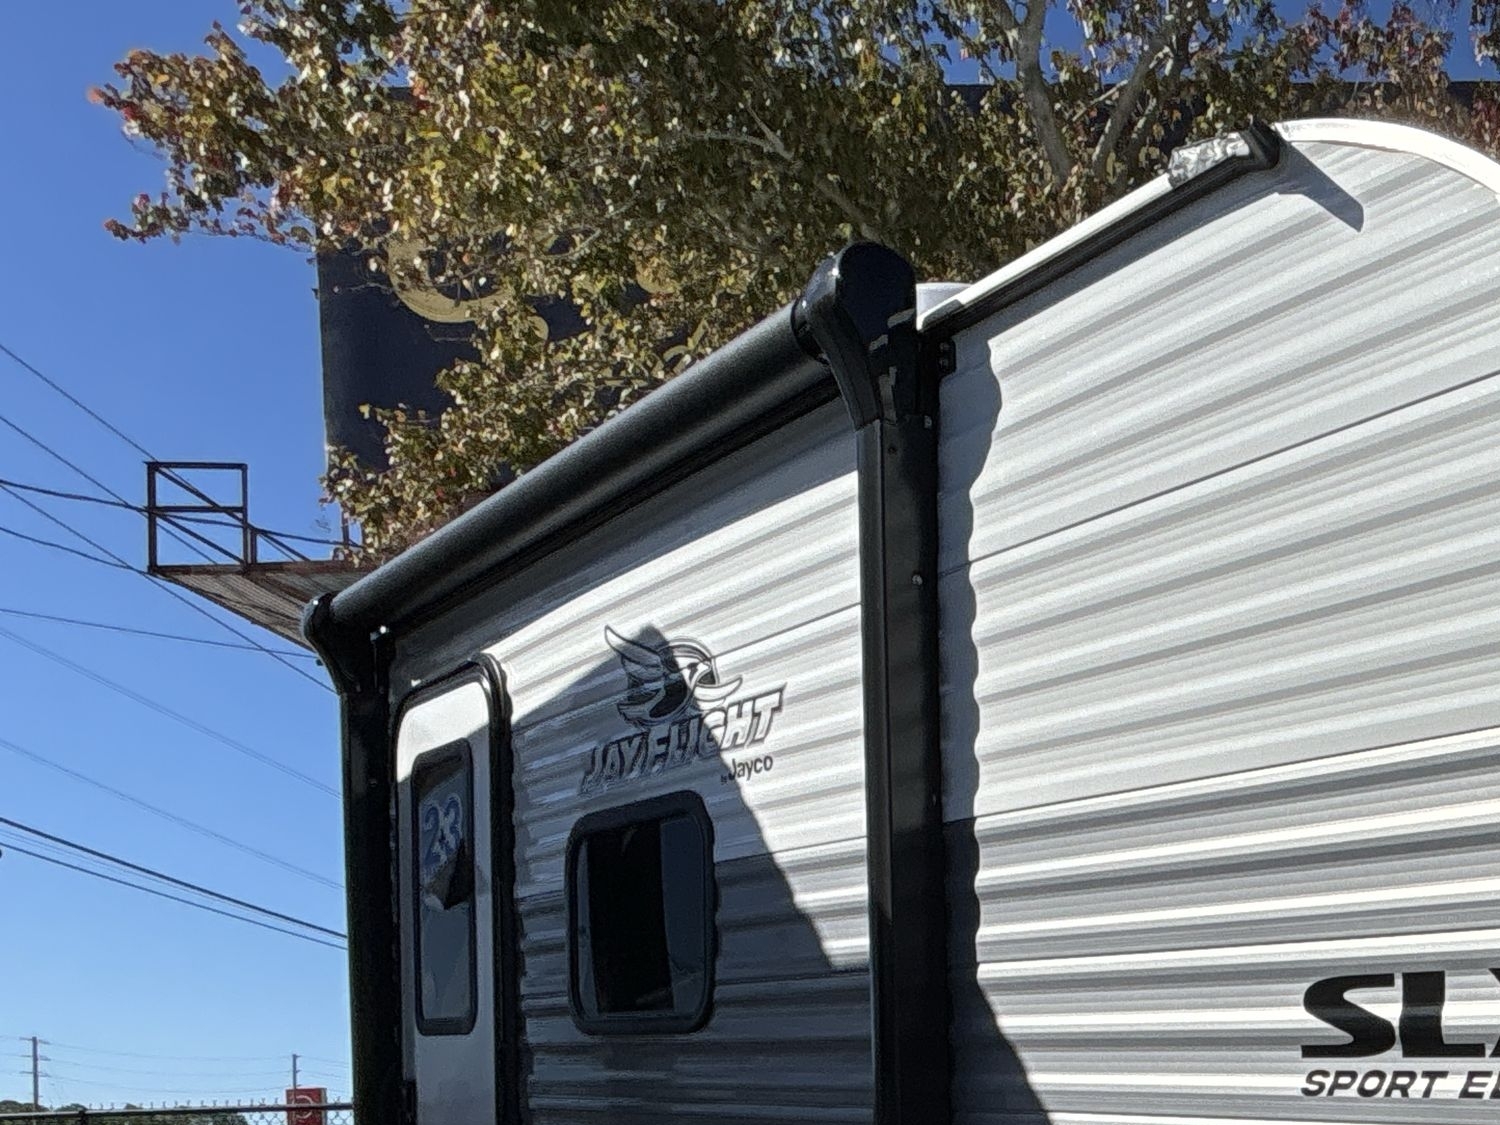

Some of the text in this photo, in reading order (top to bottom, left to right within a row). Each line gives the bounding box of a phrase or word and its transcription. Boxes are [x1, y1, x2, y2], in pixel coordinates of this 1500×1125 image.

[580, 687, 785, 793] JAY FLIGHT
[728, 755, 773, 781] Jayco
[1301, 1069, 1450, 1099] SPORT
